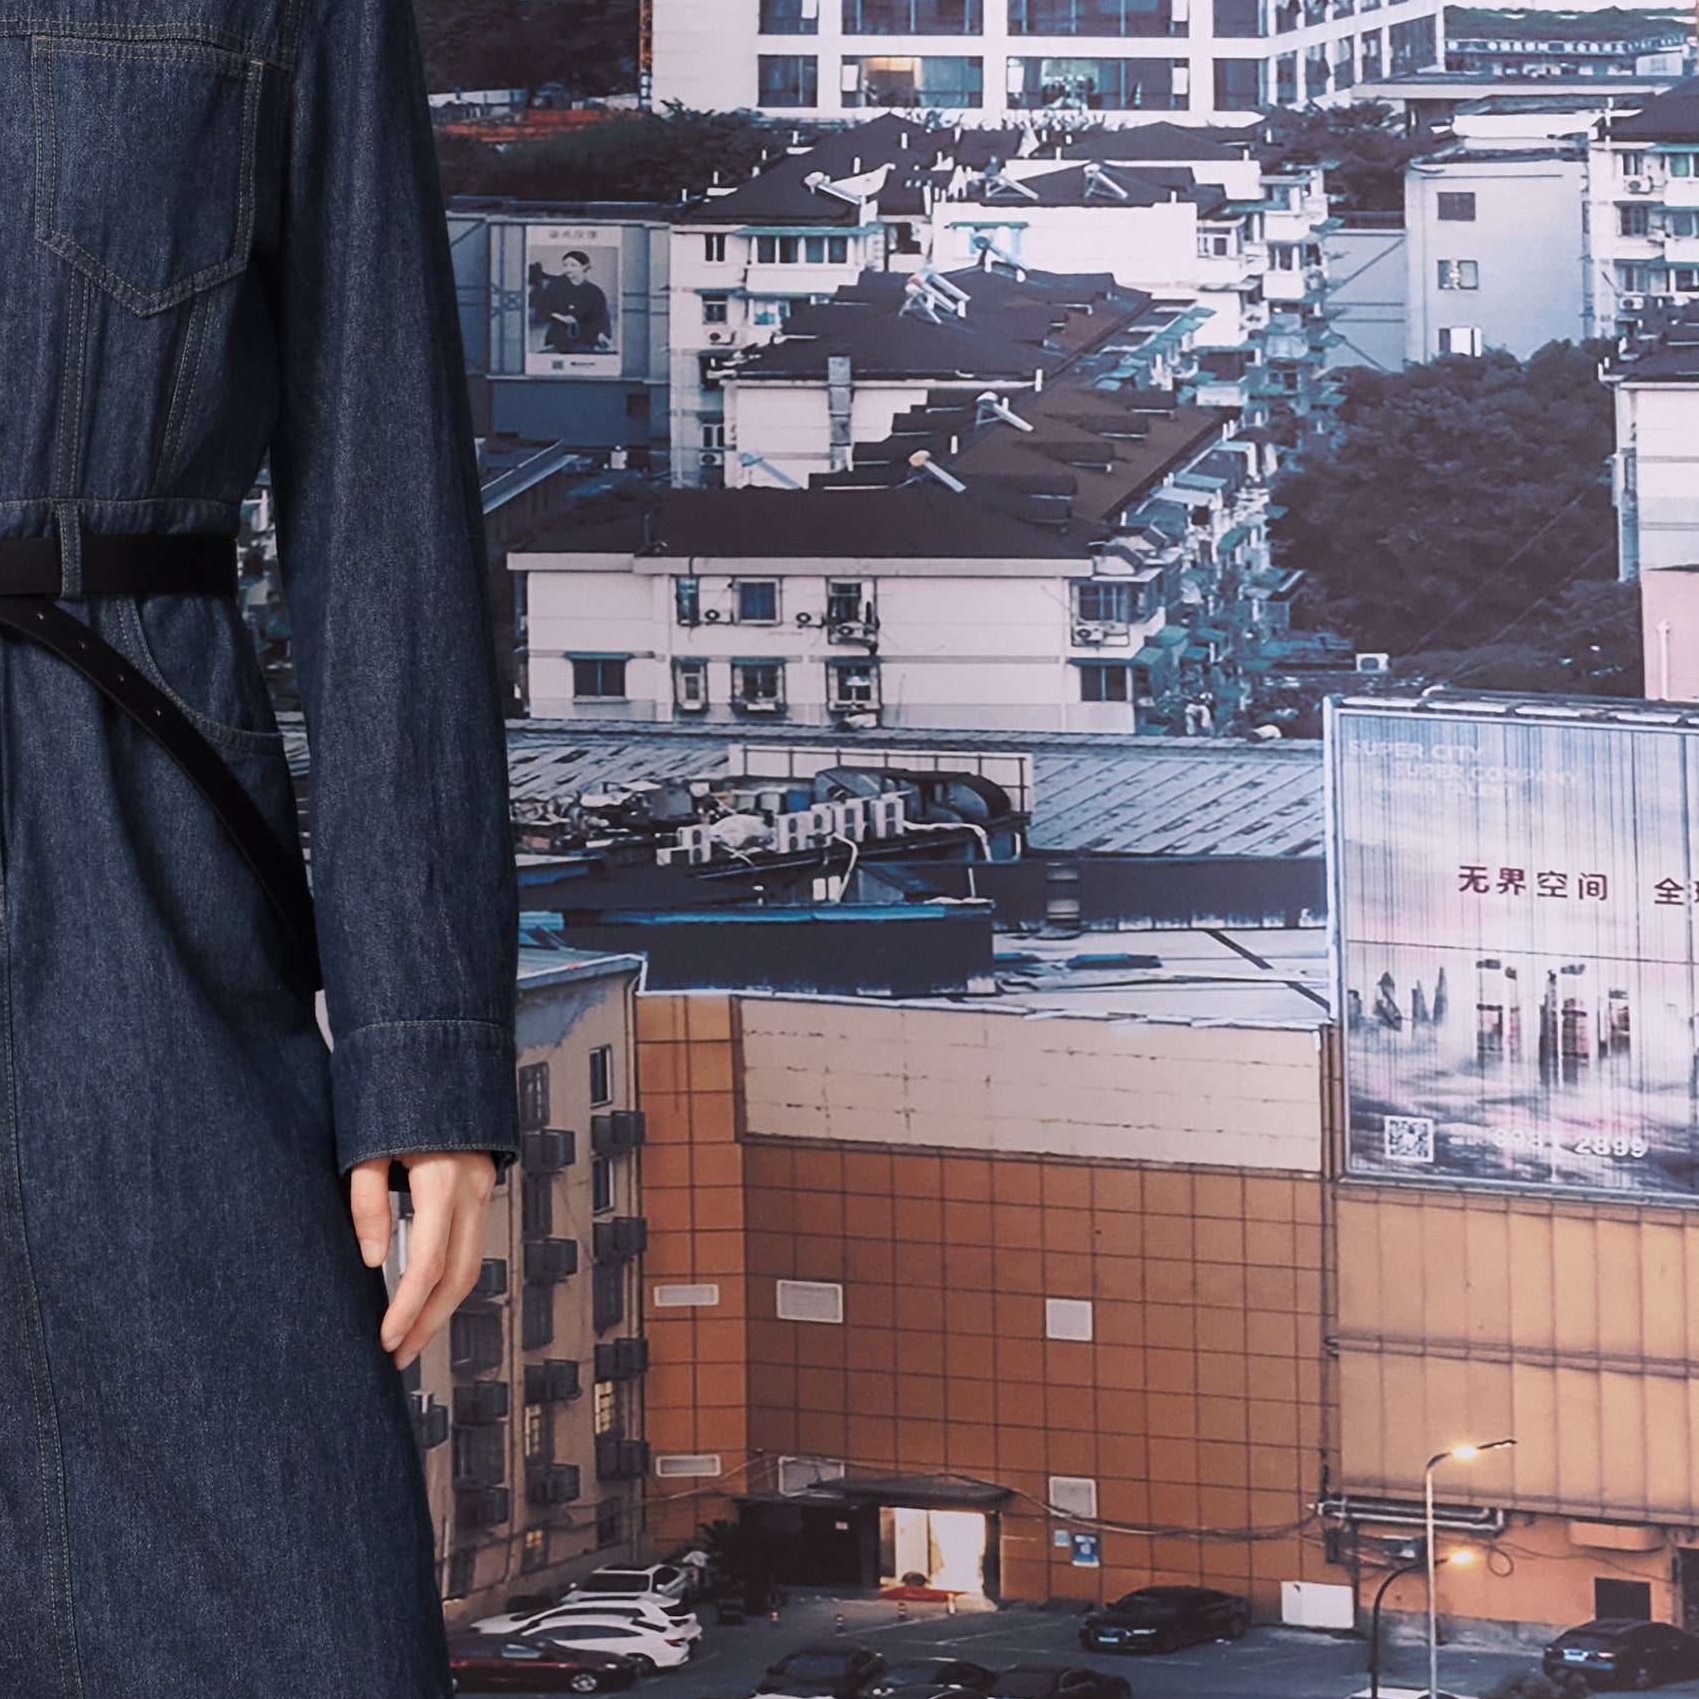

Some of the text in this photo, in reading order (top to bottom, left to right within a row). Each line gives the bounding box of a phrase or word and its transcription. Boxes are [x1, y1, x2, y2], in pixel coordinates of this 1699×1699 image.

[1458, 865, 1699, 906] 无界空间 全
